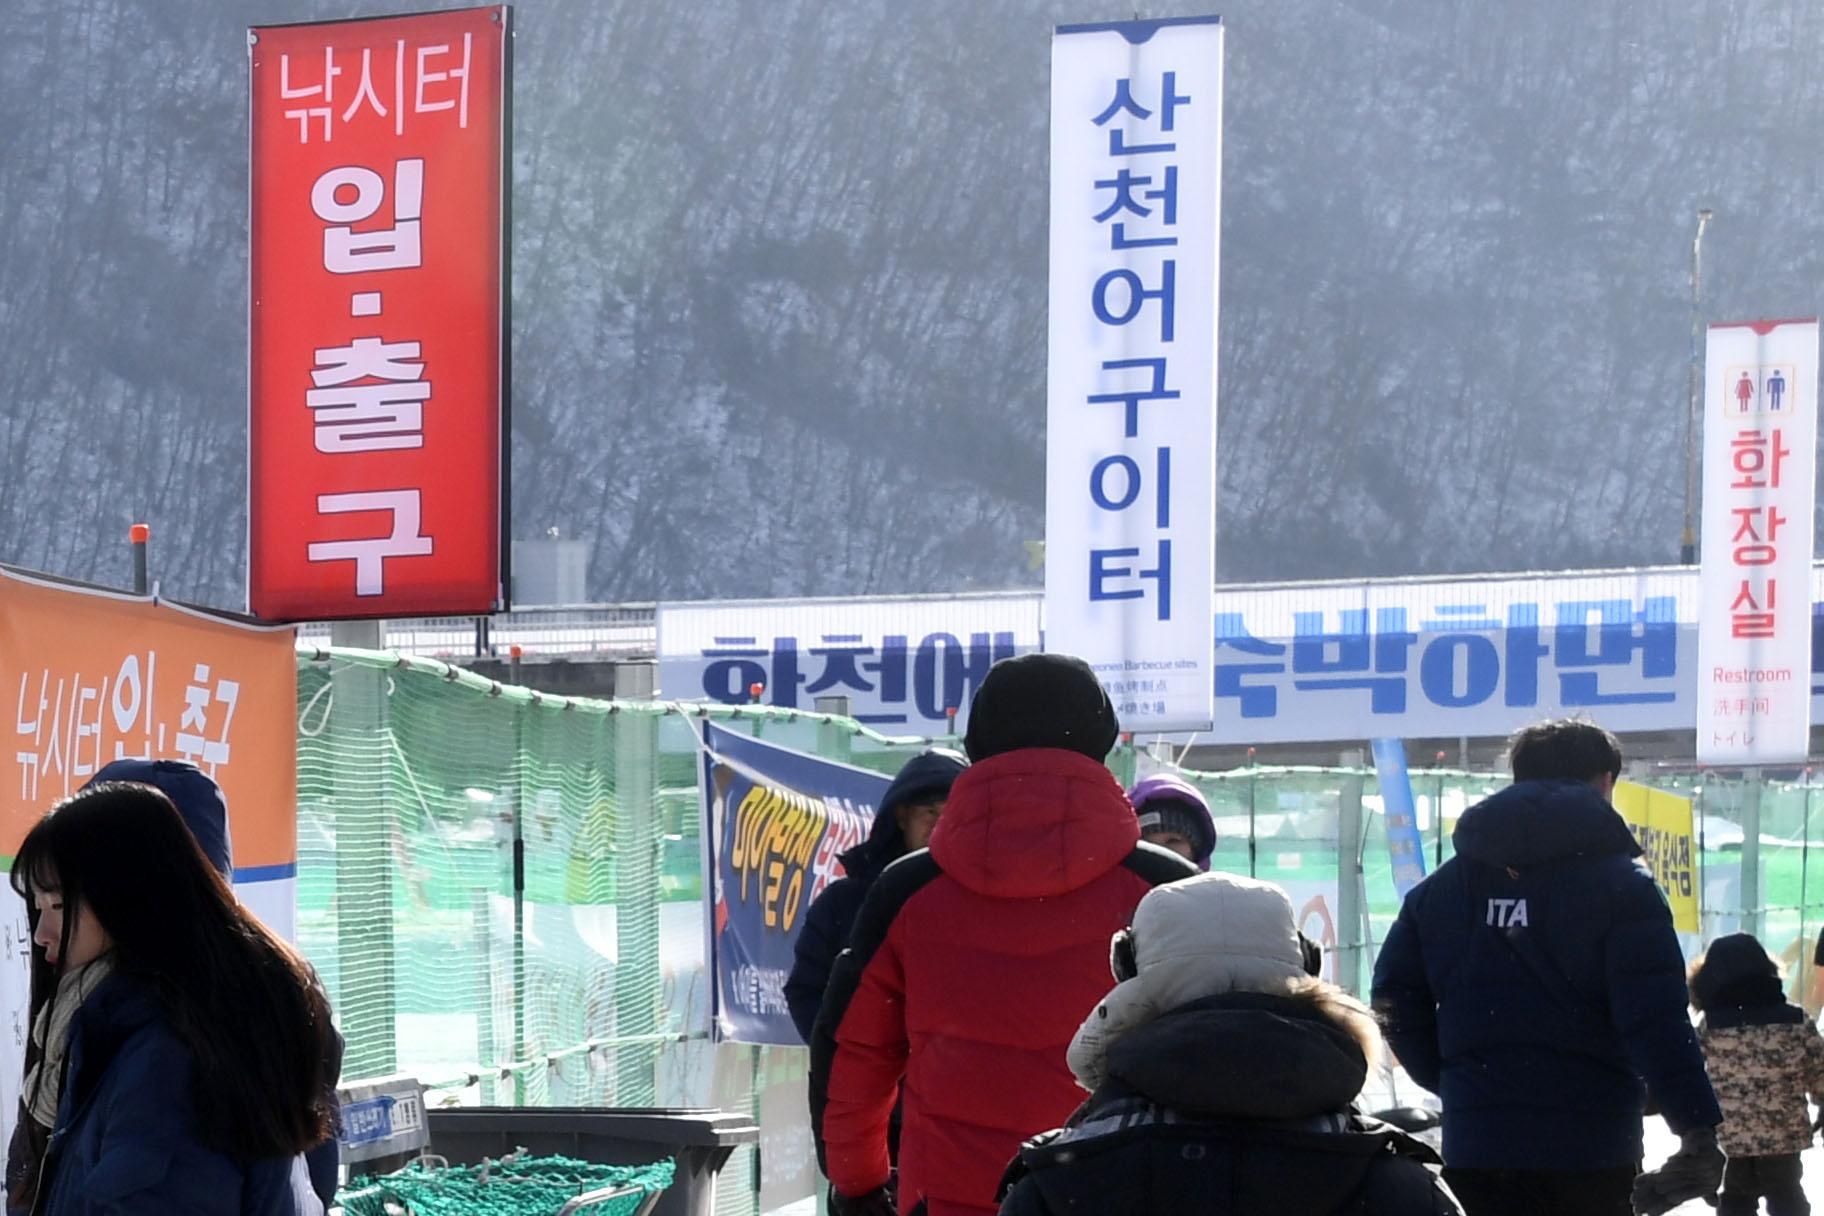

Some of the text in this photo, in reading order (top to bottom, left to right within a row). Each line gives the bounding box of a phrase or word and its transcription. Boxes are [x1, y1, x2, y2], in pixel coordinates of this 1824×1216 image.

[280, 33, 471, 143] 낚시터
[1088, 72, 1191, 622] 산천어구이터
[1730, 428, 1790, 640] 화장실
[1124, 659, 1173, 671] Barbecue
[1174, 659, 1198, 669] sites
[1713, 665, 1792, 683] Restroom
[16, 668, 109, 800] 낚시터
[1486, 898, 1528, 927] ITA
